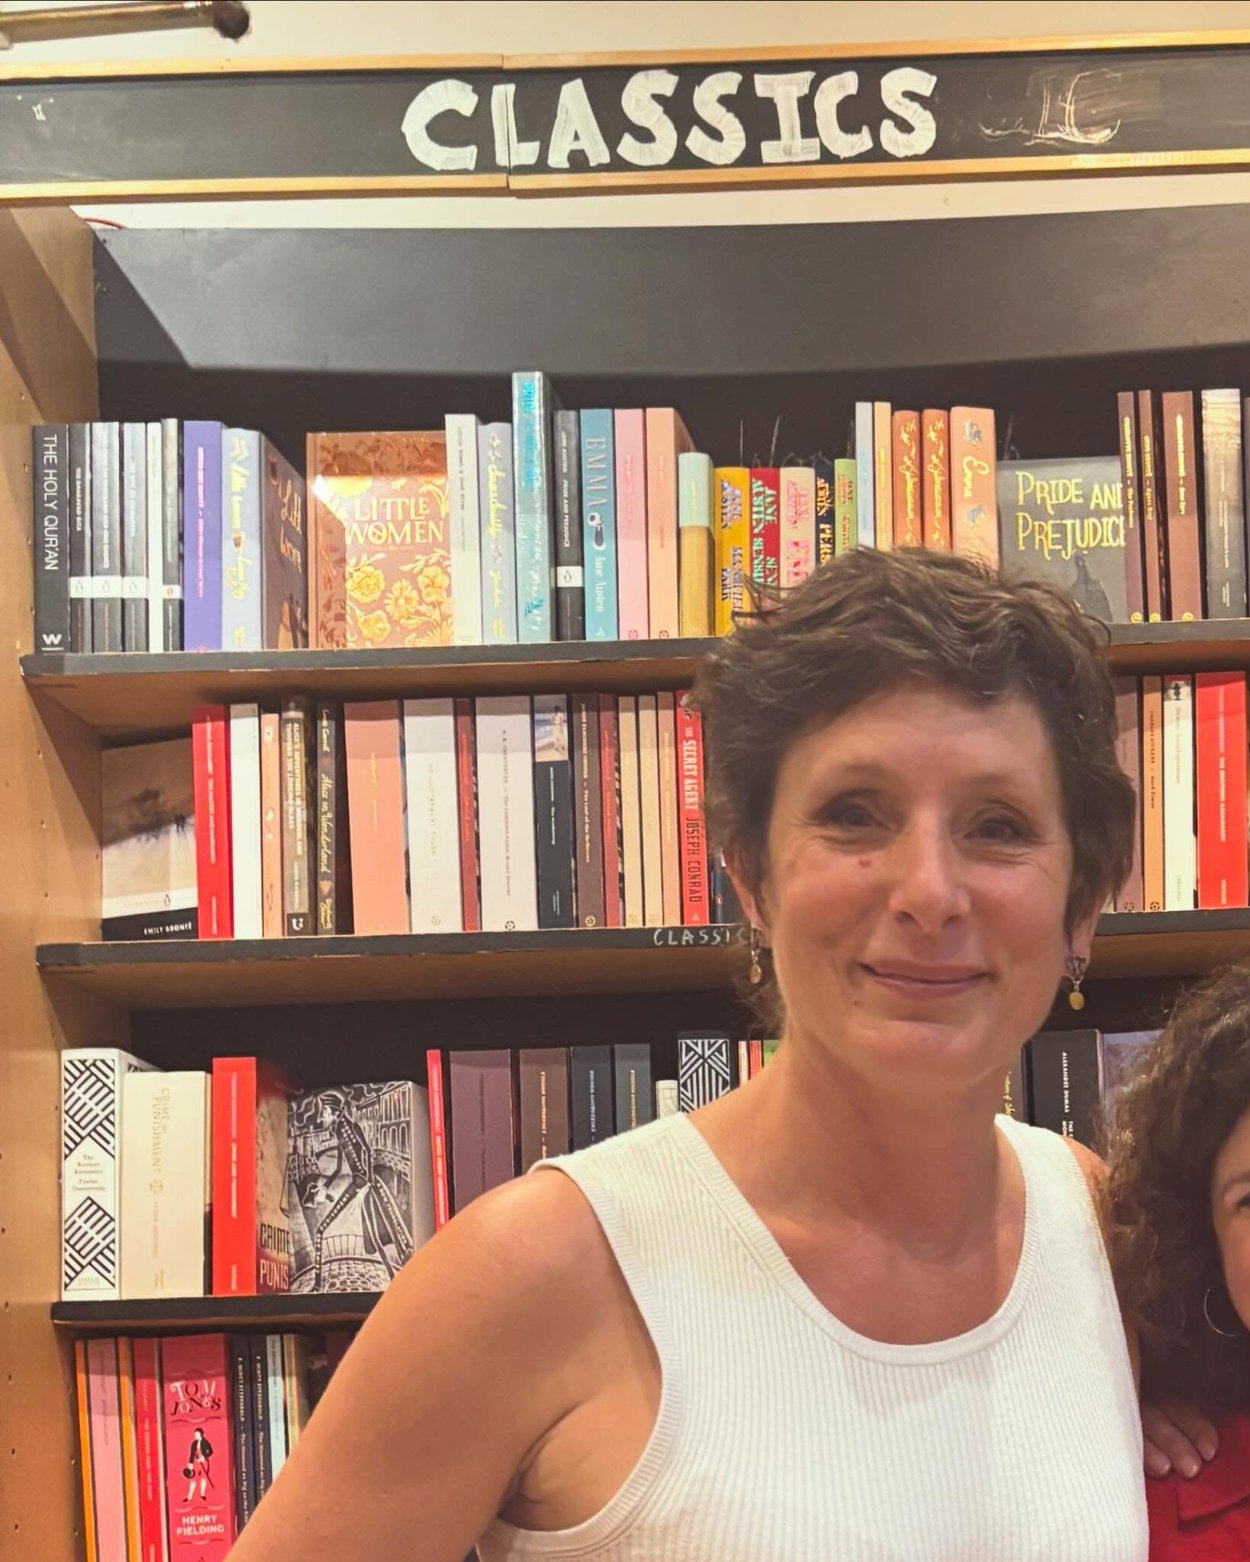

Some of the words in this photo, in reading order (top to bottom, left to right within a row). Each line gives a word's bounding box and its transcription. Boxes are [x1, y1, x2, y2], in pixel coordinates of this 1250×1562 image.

[402, 67, 936, 170] CLASSICS
[44, 434, 58, 464] THE
[44, 470, 58, 510] HOLY
[586, 438, 608, 508] EMMA
[354, 498, 430, 520] LITTLE
[1016, 471, 1084, 515] PRIDE
[346, 521, 443, 544] WOMEN
[683, 740, 697, 776] SECRET
[321, 774, 332, 798] Alice
[685, 778, 698, 810] AGENT
[321, 812, 332, 874] Wonderland
[686, 817, 700, 856] JOSEPH
[687, 860, 702, 903] CONRAD
[144, 926, 163, 935] EMILY
[182, 1516, 217, 1526] HENRY
